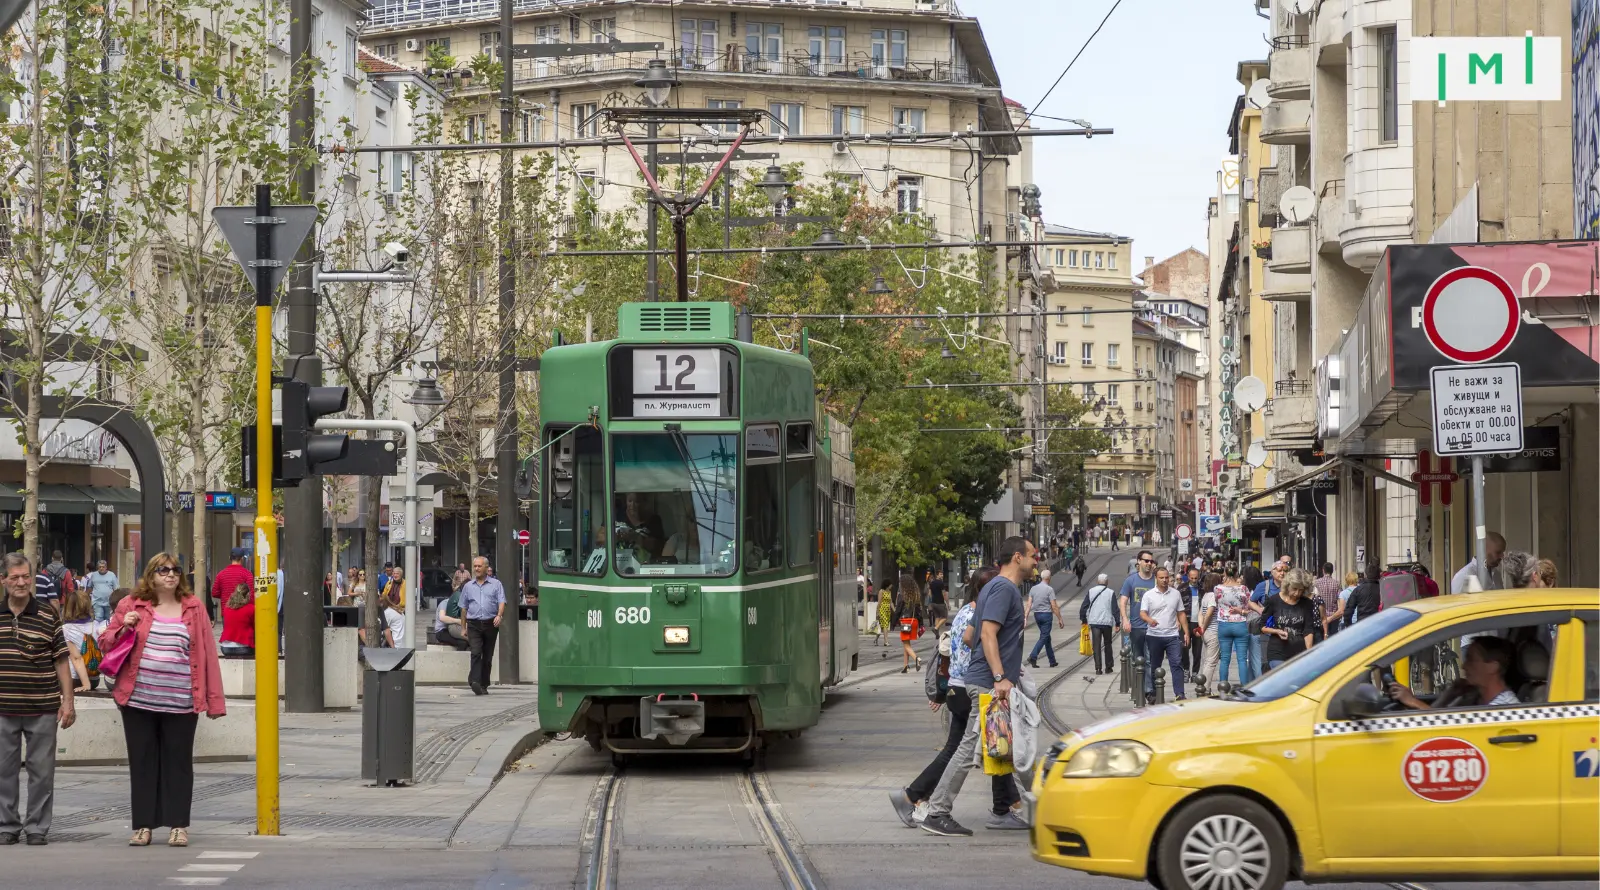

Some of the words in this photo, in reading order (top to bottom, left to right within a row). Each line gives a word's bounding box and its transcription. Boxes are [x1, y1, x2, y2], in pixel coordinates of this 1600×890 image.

[654, 354, 696, 391] 12
[1448, 376, 1460, 387] Не
[1464, 377, 1488, 387] важи
[1492, 376, 1503, 385] за
[1453, 391, 1490, 403] живущи
[1494, 390, 1500, 399] и
[659, 401, 711, 411] Журналист
[1443, 405, 1497, 418] обслужване
[1500, 404, 1512, 413] на
[1440, 419, 1471, 430] обекти
[1475, 420, 1485, 429] от
[1489, 416, 1516, 428] 00.00
[1445, 436, 1457, 446] до
[1461, 432, 1488, 443] 05.00
[1490, 433, 1511, 442] часа
[1522, 450, 1555, 458] OPTICS
[587, 609, 602, 629] 680
[615, 606, 651, 624] 680
[747, 606, 758, 625] 680
